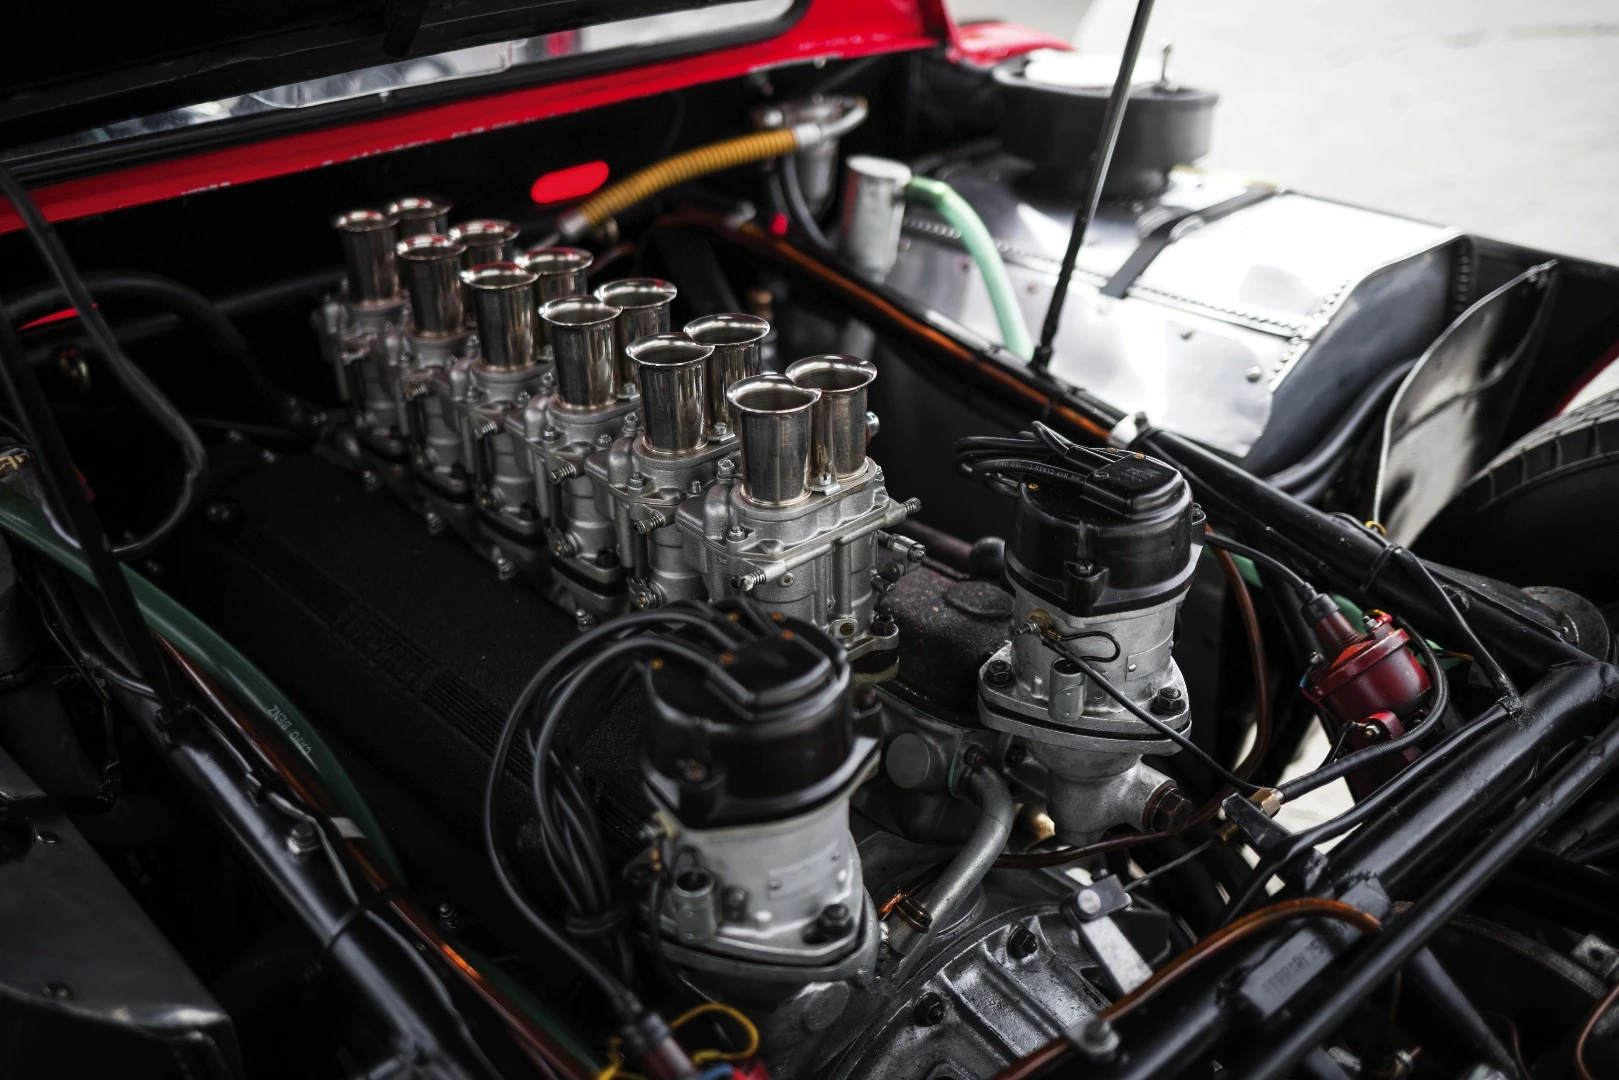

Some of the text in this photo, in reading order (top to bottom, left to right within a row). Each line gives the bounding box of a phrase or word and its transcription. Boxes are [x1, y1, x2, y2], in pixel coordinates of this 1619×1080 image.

[1035, 465, 1055, 475] CLASS
[267, 704, 312, 754] CAVO BENZ
